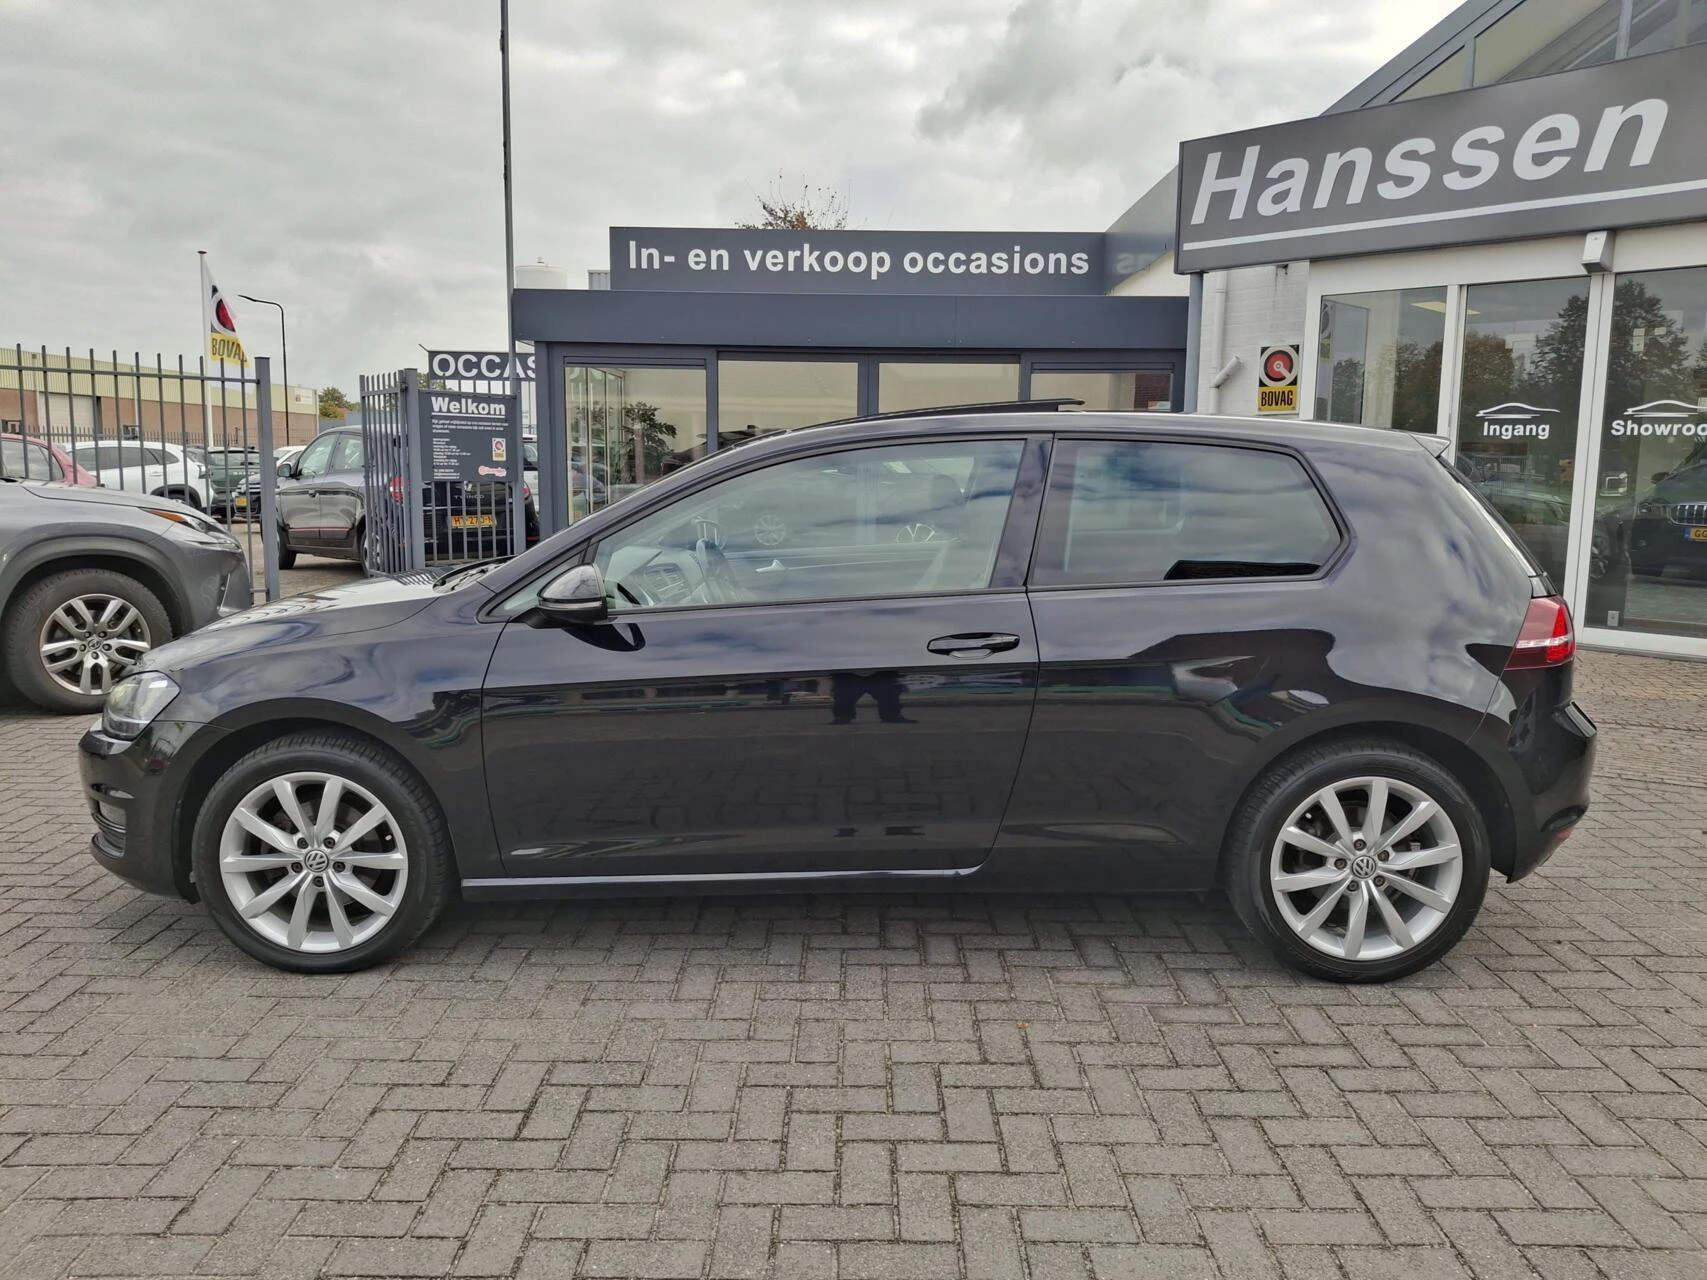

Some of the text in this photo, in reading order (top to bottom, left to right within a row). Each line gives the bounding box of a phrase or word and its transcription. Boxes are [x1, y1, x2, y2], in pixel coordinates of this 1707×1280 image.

[1190, 98, 1669, 225] Hanssen
[629, 240, 1089, 280] In- en verkoop occasions
[431, 396, 506, 415] Welkom
[1260, 389, 1293, 407] BOVAG
[1483, 421, 1550, 440] Ingang
[1611, 420, 1707, 436] Showroo
